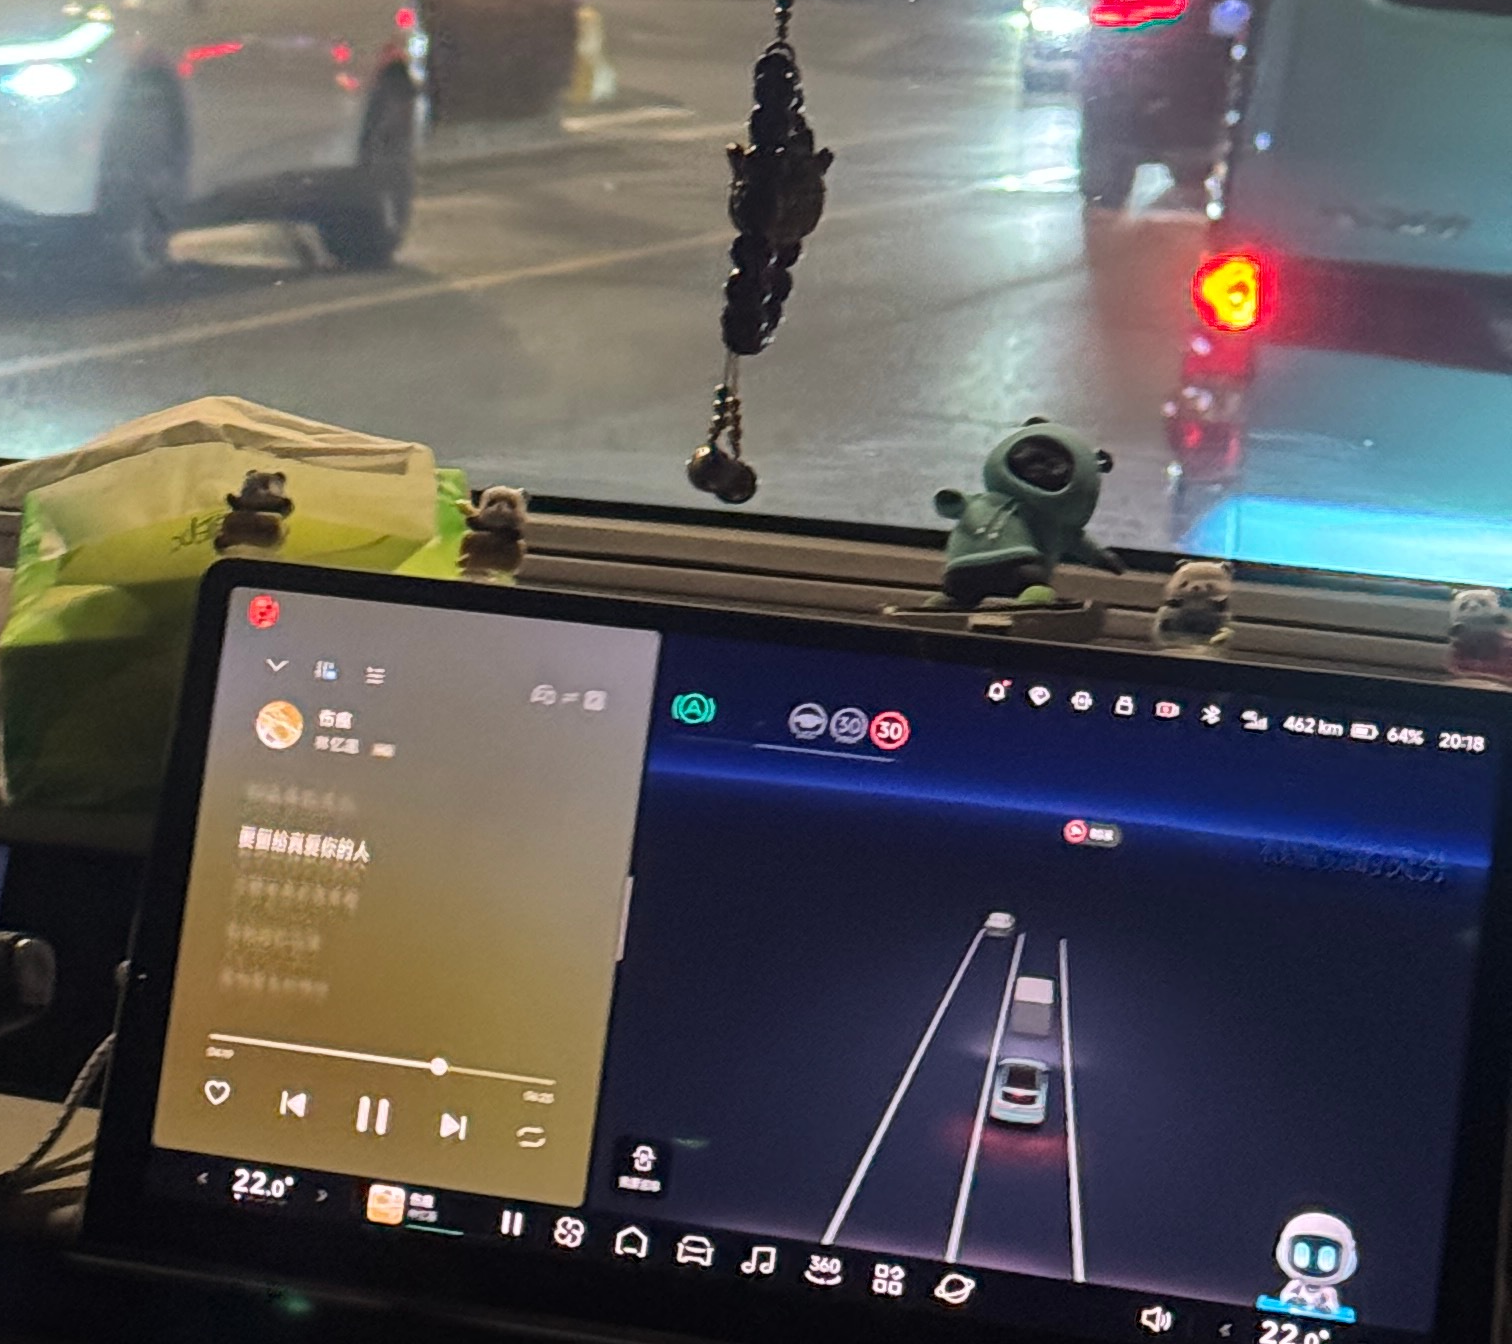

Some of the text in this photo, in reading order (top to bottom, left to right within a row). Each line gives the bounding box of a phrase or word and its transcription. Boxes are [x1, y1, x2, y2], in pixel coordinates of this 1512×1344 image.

[838, 716, 862, 735] 30
[877, 721, 903, 741] 30
[1282, 715, 1486, 753] 462 km 64% 20:18
[808, 1254, 841, 1275] 360
